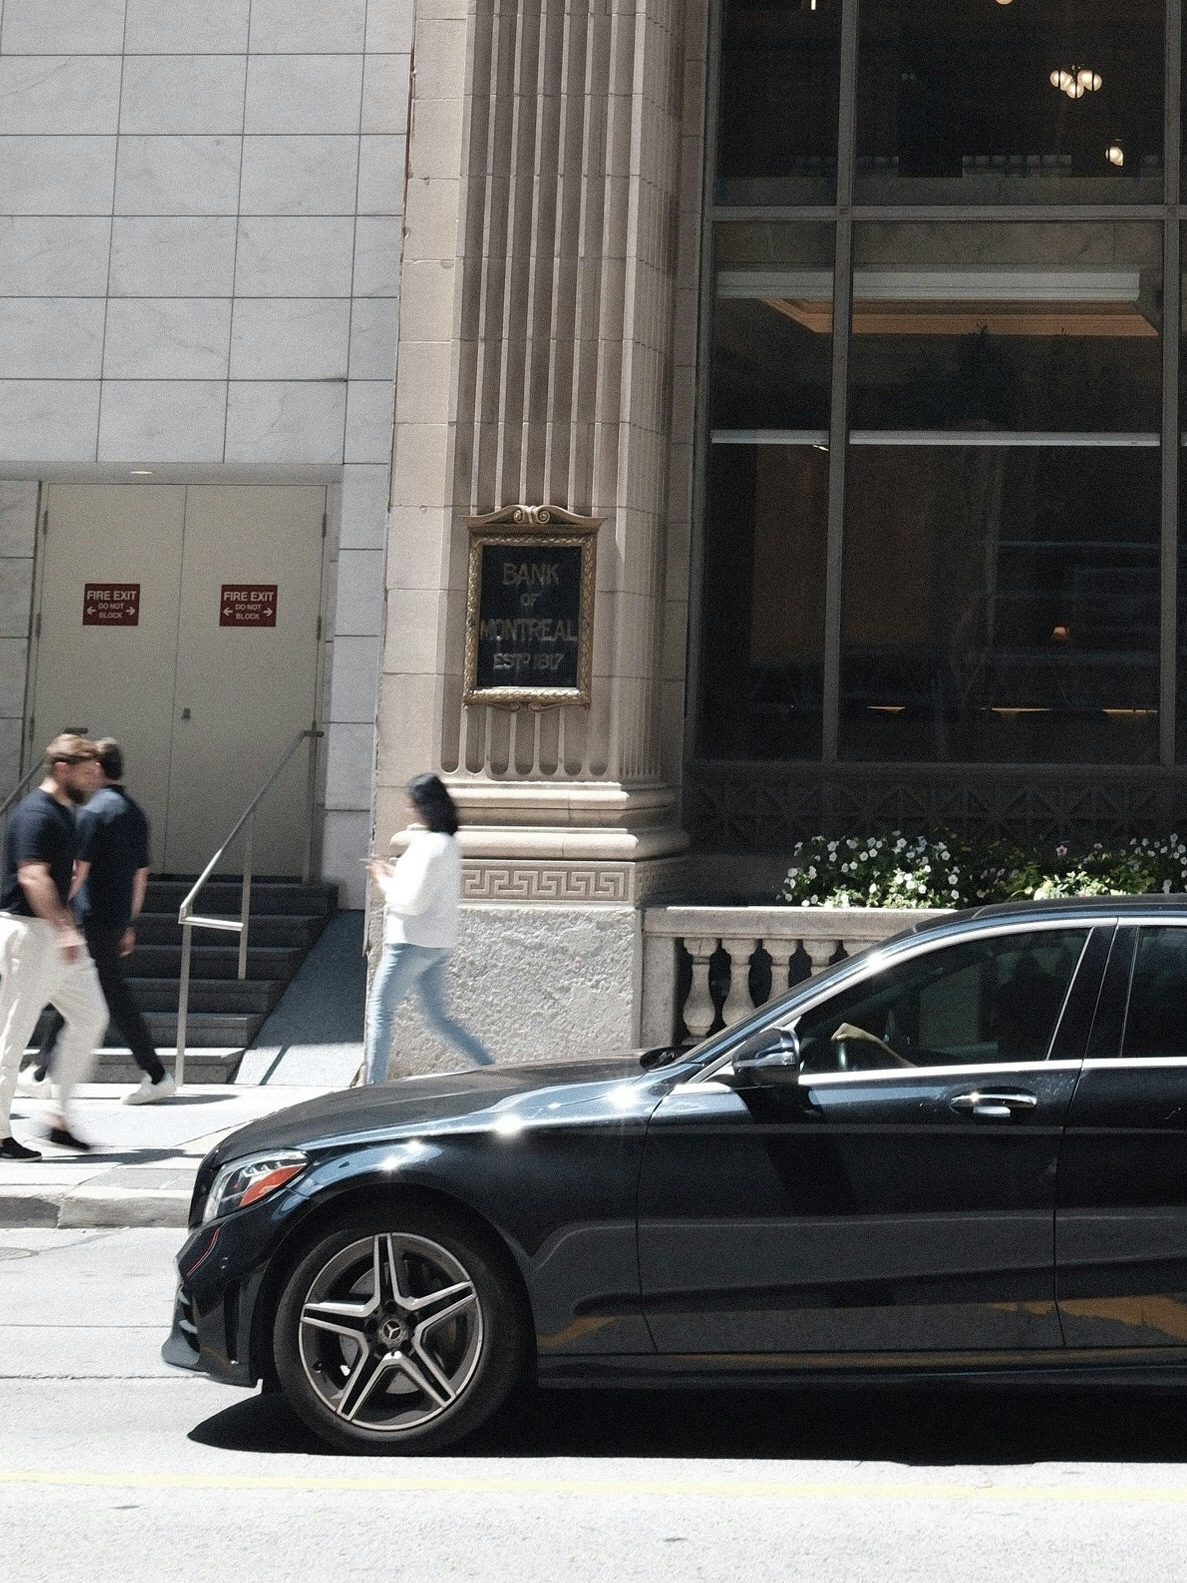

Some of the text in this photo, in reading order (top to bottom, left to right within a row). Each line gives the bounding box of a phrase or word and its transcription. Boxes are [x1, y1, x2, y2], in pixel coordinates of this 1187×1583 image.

[503, 562, 560, 586] BANK
[87, 590, 137, 601] FIRE EXIT
[224, 591, 274, 602] FIRE EXIT
[520, 593, 541, 607] OF
[480, 618, 578, 641] MONTREAL
